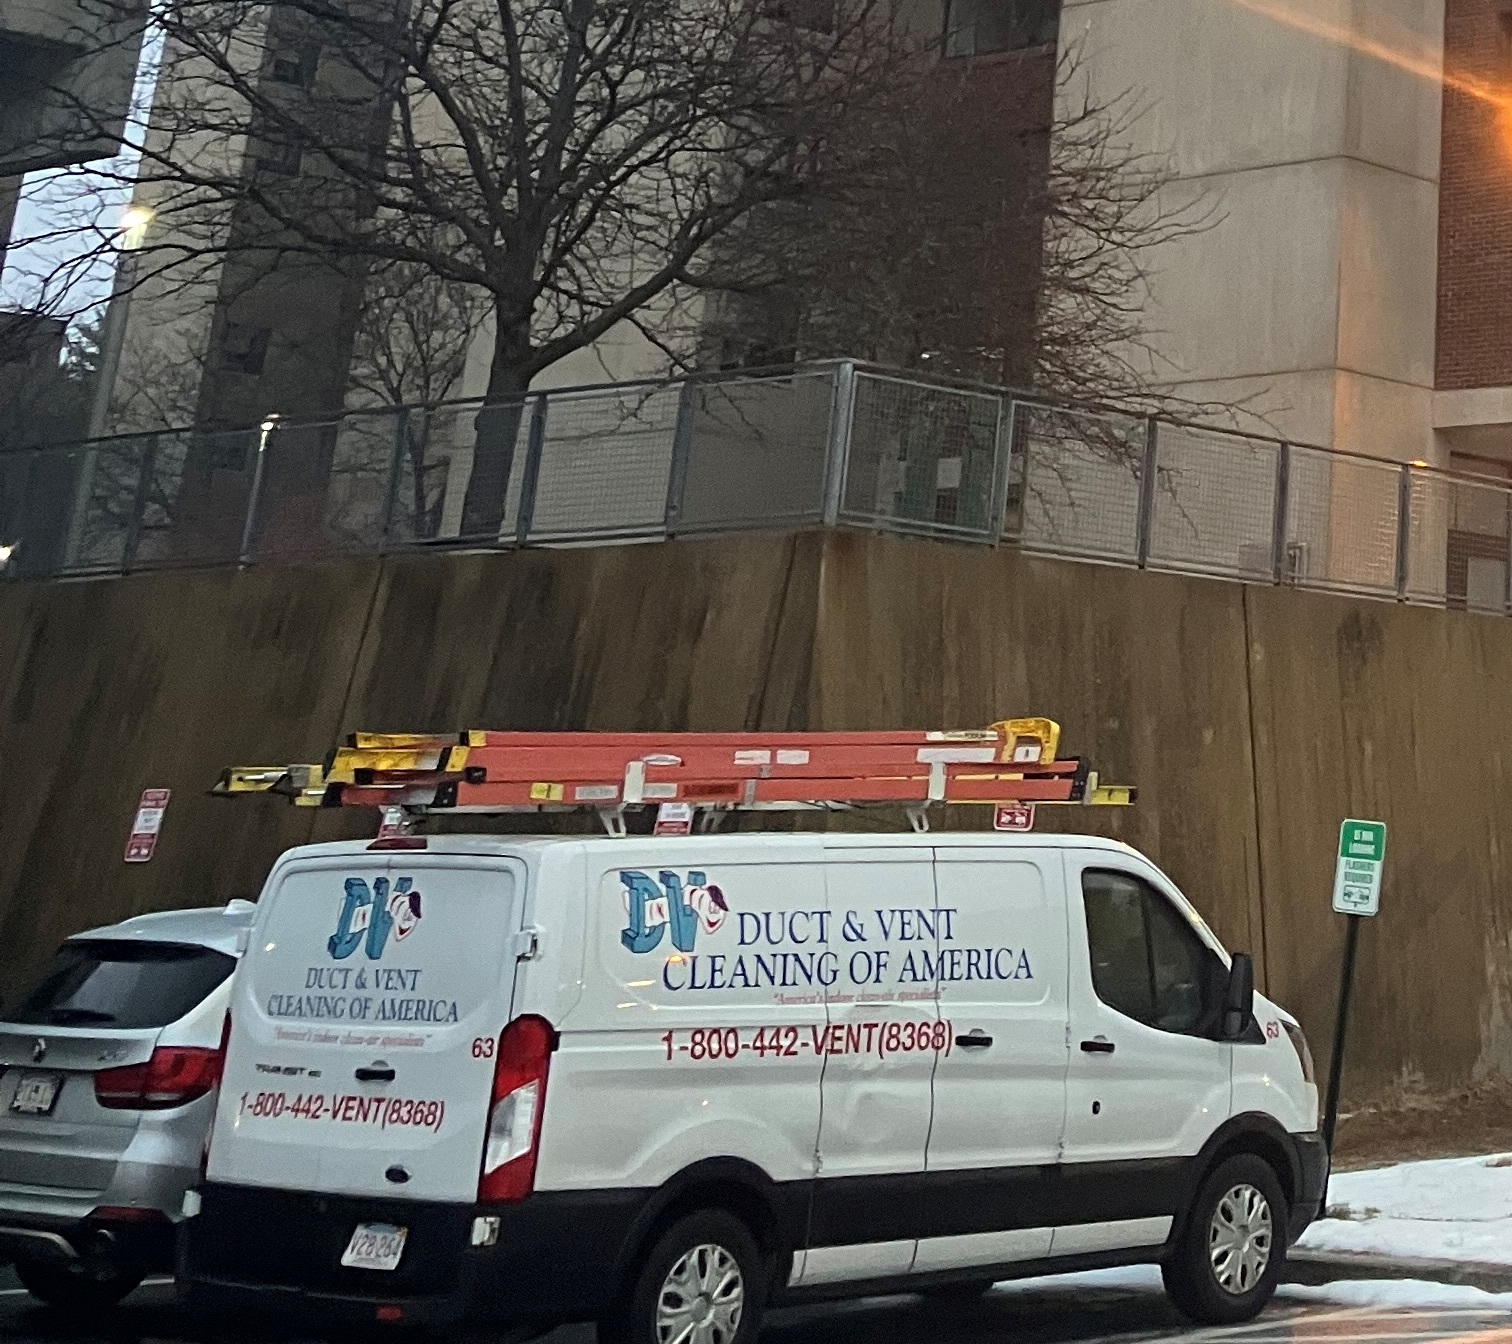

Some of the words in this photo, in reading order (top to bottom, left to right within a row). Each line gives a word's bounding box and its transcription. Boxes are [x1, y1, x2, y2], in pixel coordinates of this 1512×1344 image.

[737, 910, 831, 946] DUCT
[842, 909, 868, 943] &
[875, 908, 958, 942] VENT
[305, 967, 353, 990] DUCT
[354, 967, 368, 990] &
[375, 968, 422, 992] VENT
[662, 951, 840, 991] CLEANING
[849, 950, 889, 986] OF
[899, 948, 1034, 984] AMERICA
[267, 994, 346, 1019] CLEANING
[349, 997, 375, 1020] OF
[375, 999, 459, 1023] AMERICA
[661, 1021, 954, 1061] 1-800-442-VENT(8368)
[1266, 1021, 1280, 1039] 63
[471, 1037, 495, 1059] 63
[239, 1091, 445, 1133] 1-800-442-VENT(8368)
